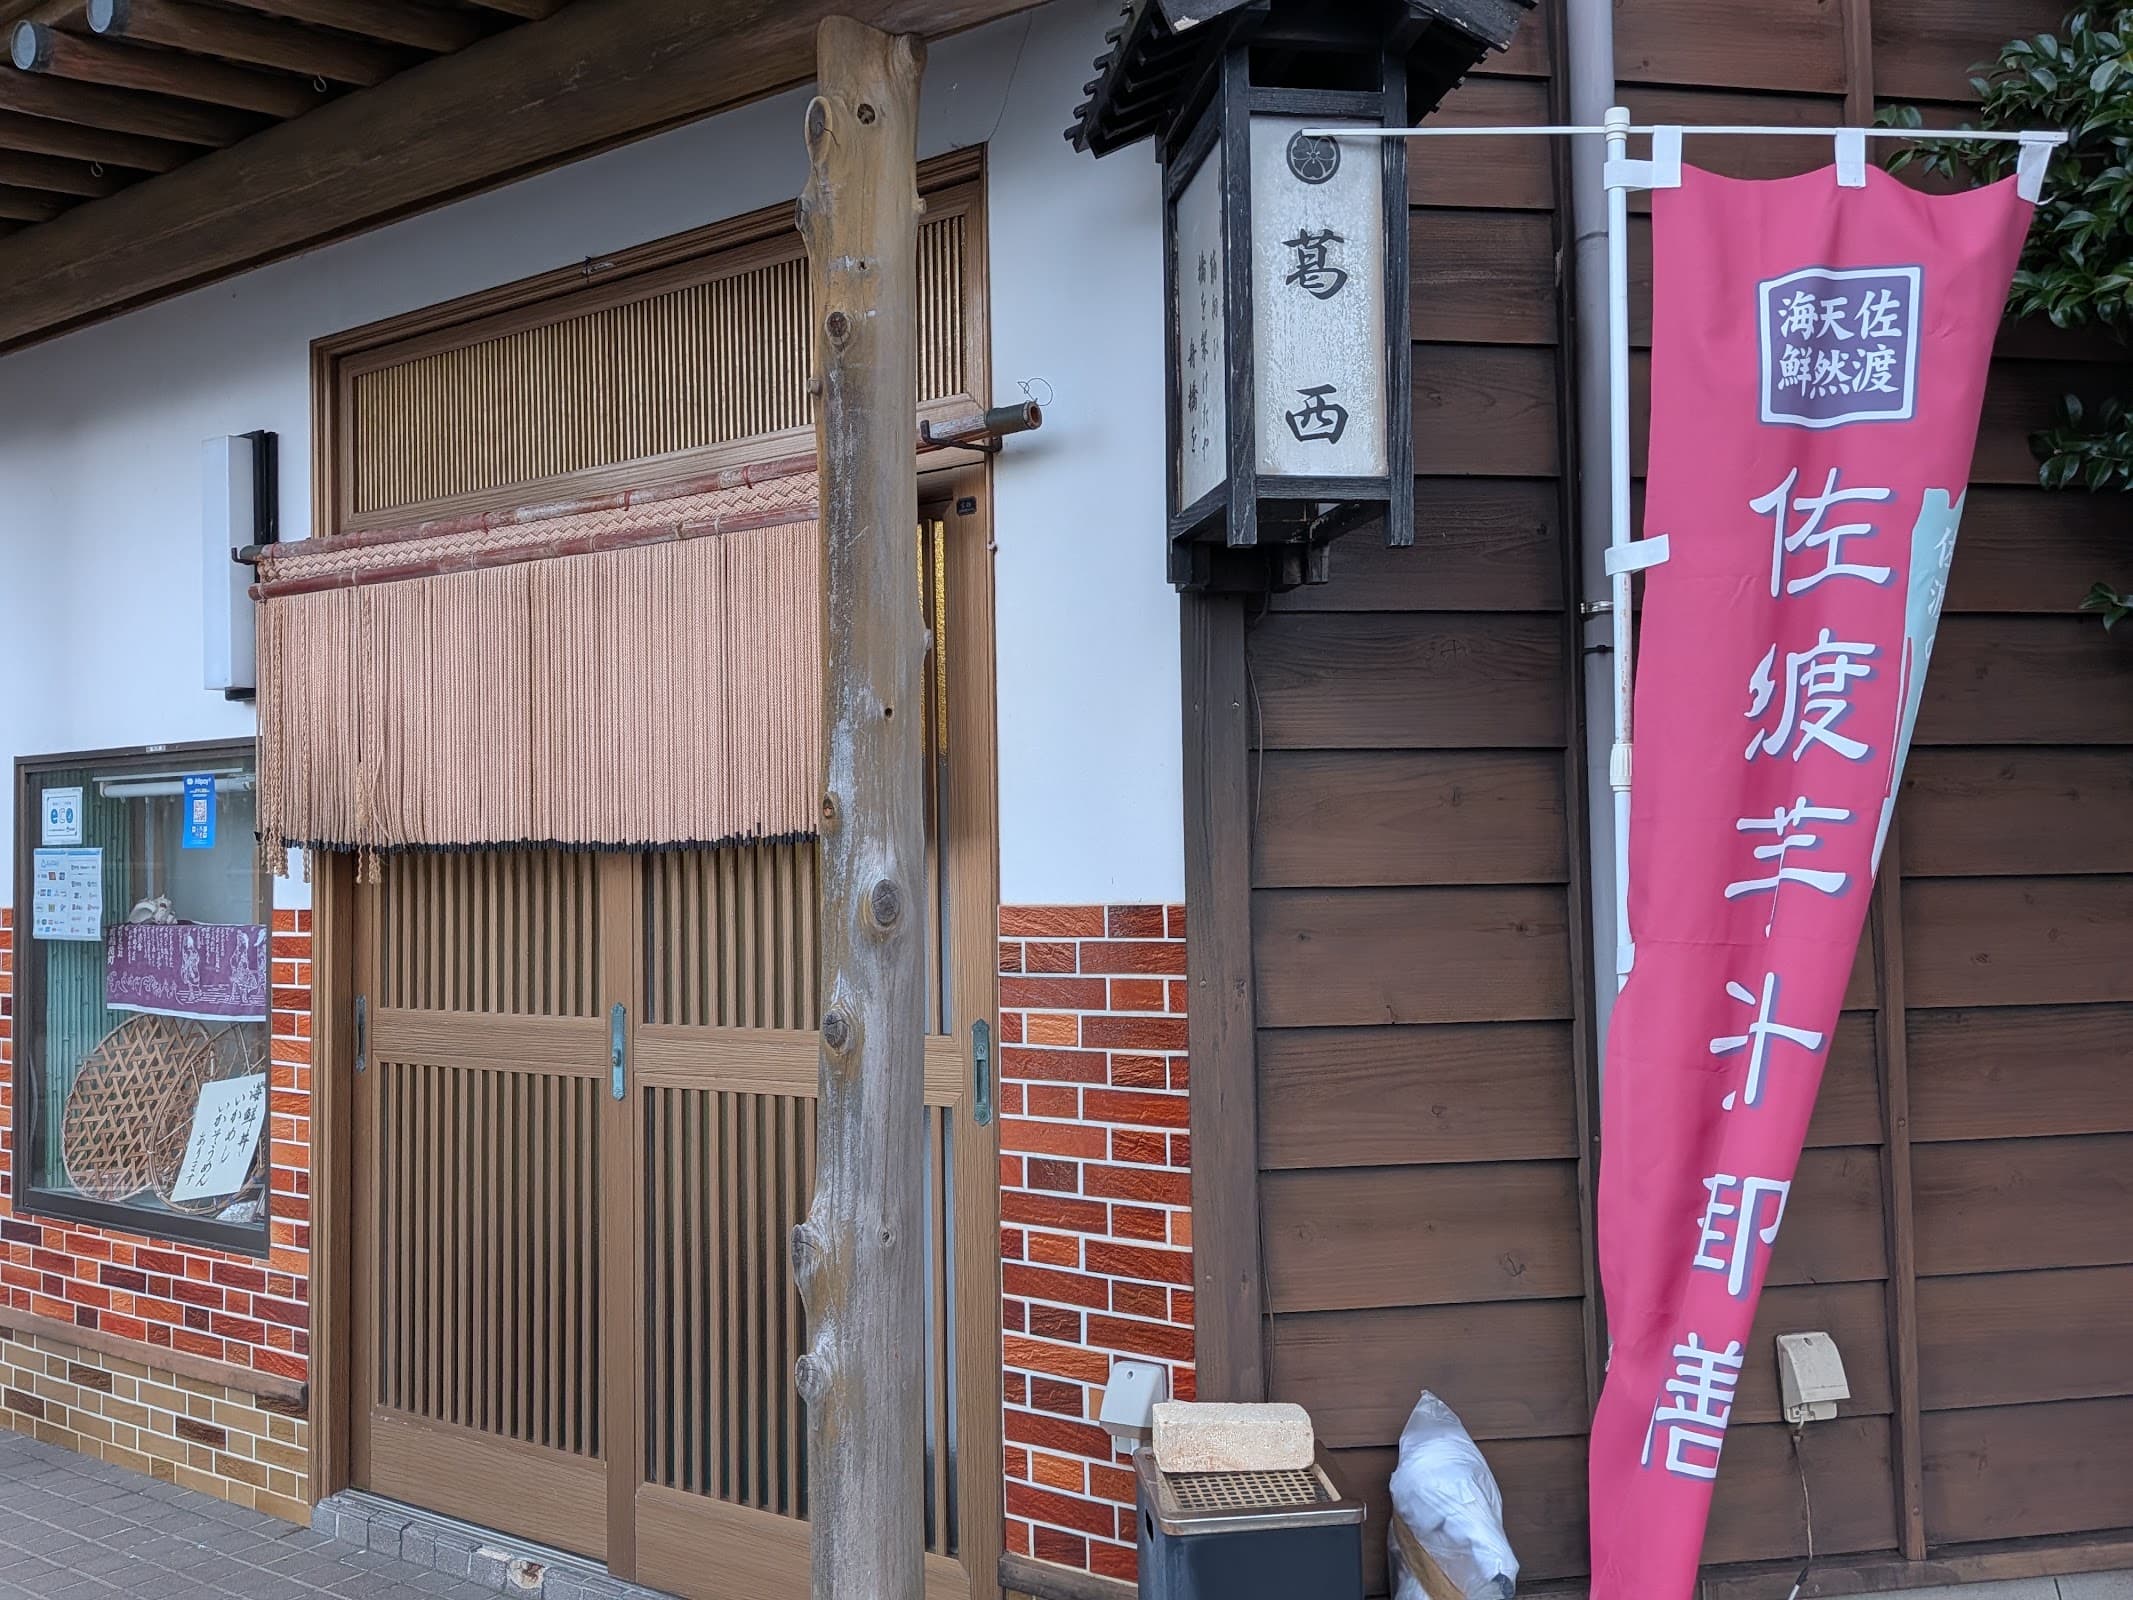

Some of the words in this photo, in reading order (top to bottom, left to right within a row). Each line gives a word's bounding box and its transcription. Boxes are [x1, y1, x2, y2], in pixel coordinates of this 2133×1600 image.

[1281, 228, 1349, 445] 葛西
[1777, 291, 1819, 397] 海鮮
[1810, 296, 1855, 400] 天然
[1851, 288, 1903, 394] 佐渡
